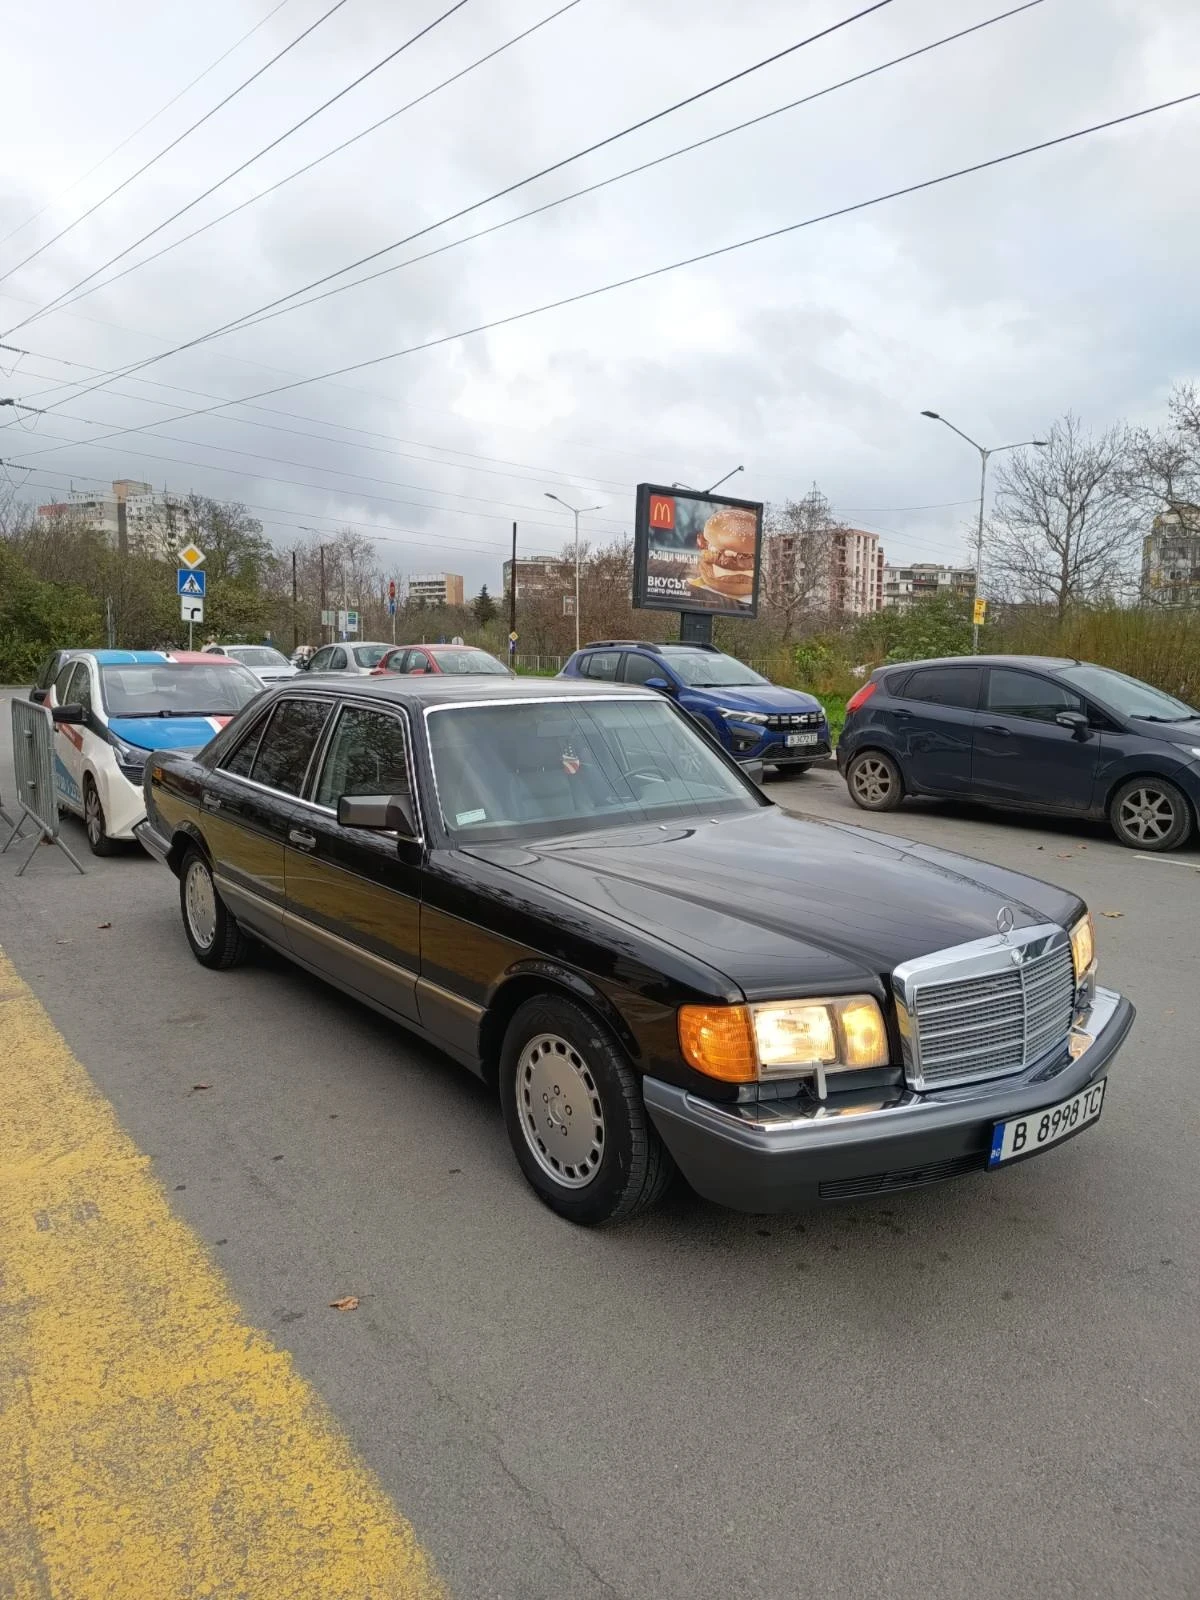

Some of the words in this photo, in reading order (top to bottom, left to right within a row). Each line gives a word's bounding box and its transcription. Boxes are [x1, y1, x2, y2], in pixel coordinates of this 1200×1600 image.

[1012, 1121, 1027, 1153] B
[1037, 1099, 1080, 1143] 8998
[1083, 1086, 1101, 1119] TC
